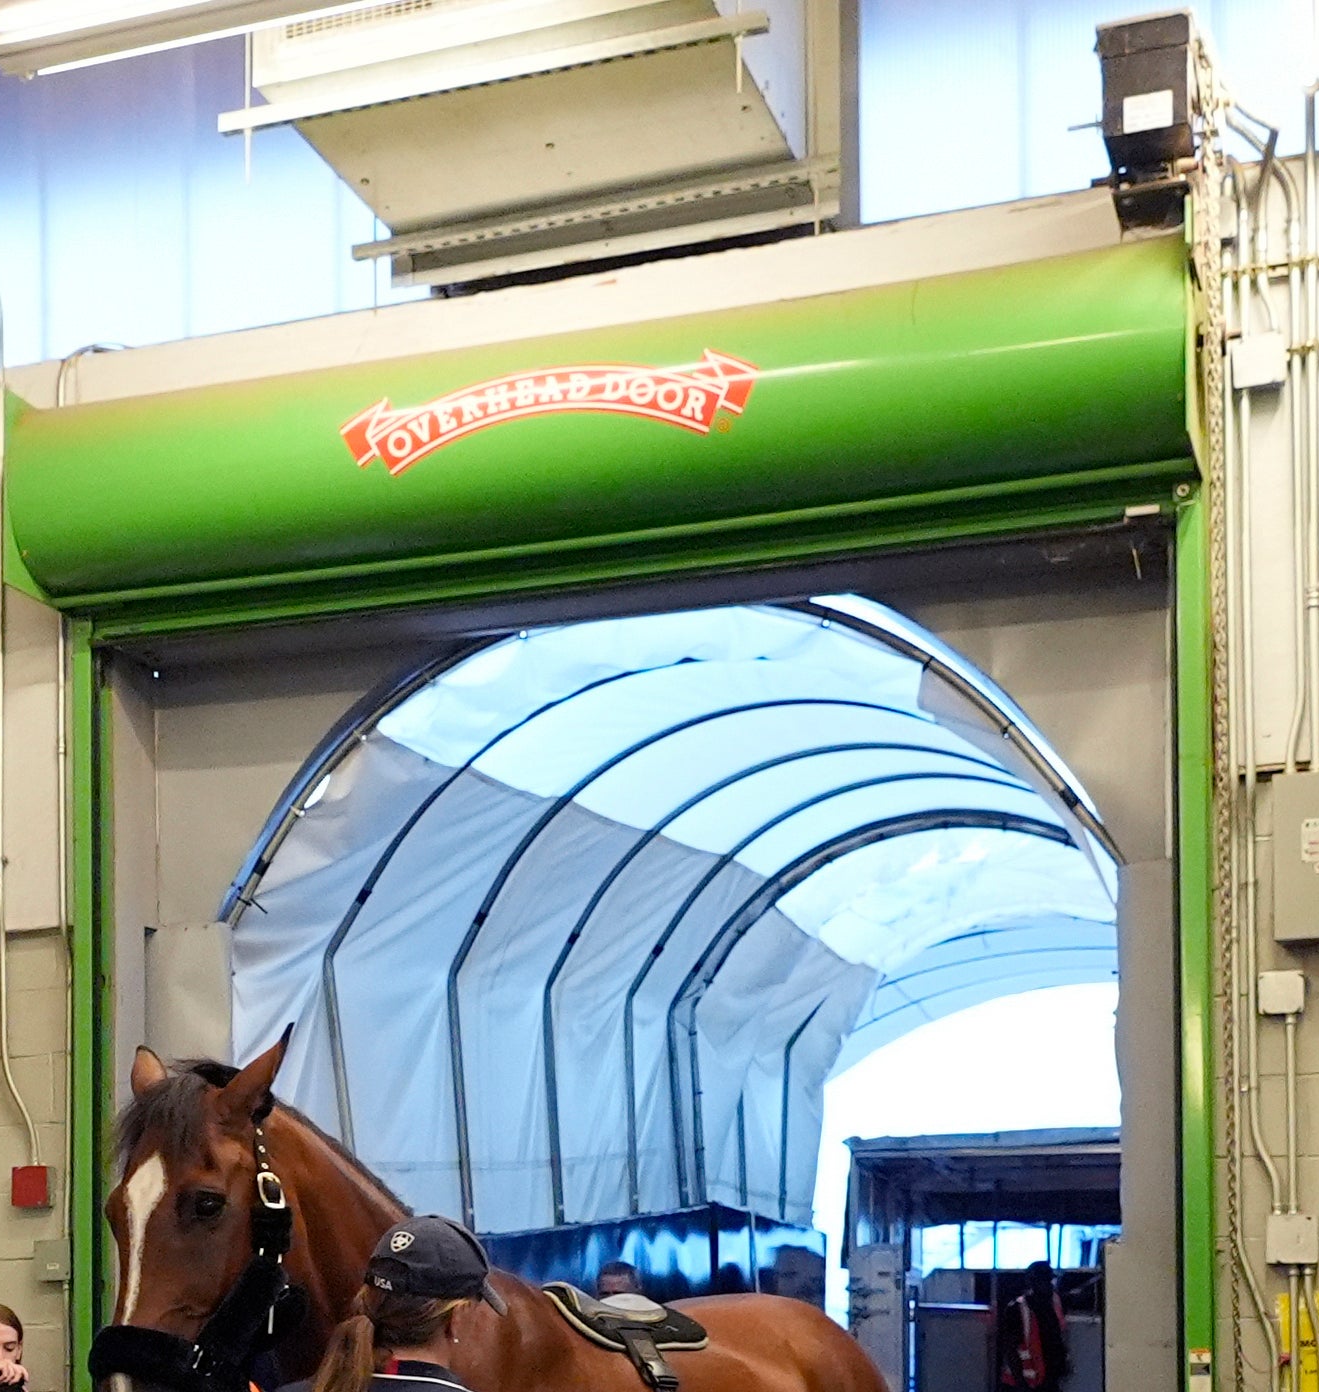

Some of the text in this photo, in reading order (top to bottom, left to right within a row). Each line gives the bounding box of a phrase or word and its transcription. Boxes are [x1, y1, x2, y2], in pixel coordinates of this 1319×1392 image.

[386, 373, 706, 458] OVERHEAD DOOR
[374, 1275, 393, 1291] USA
